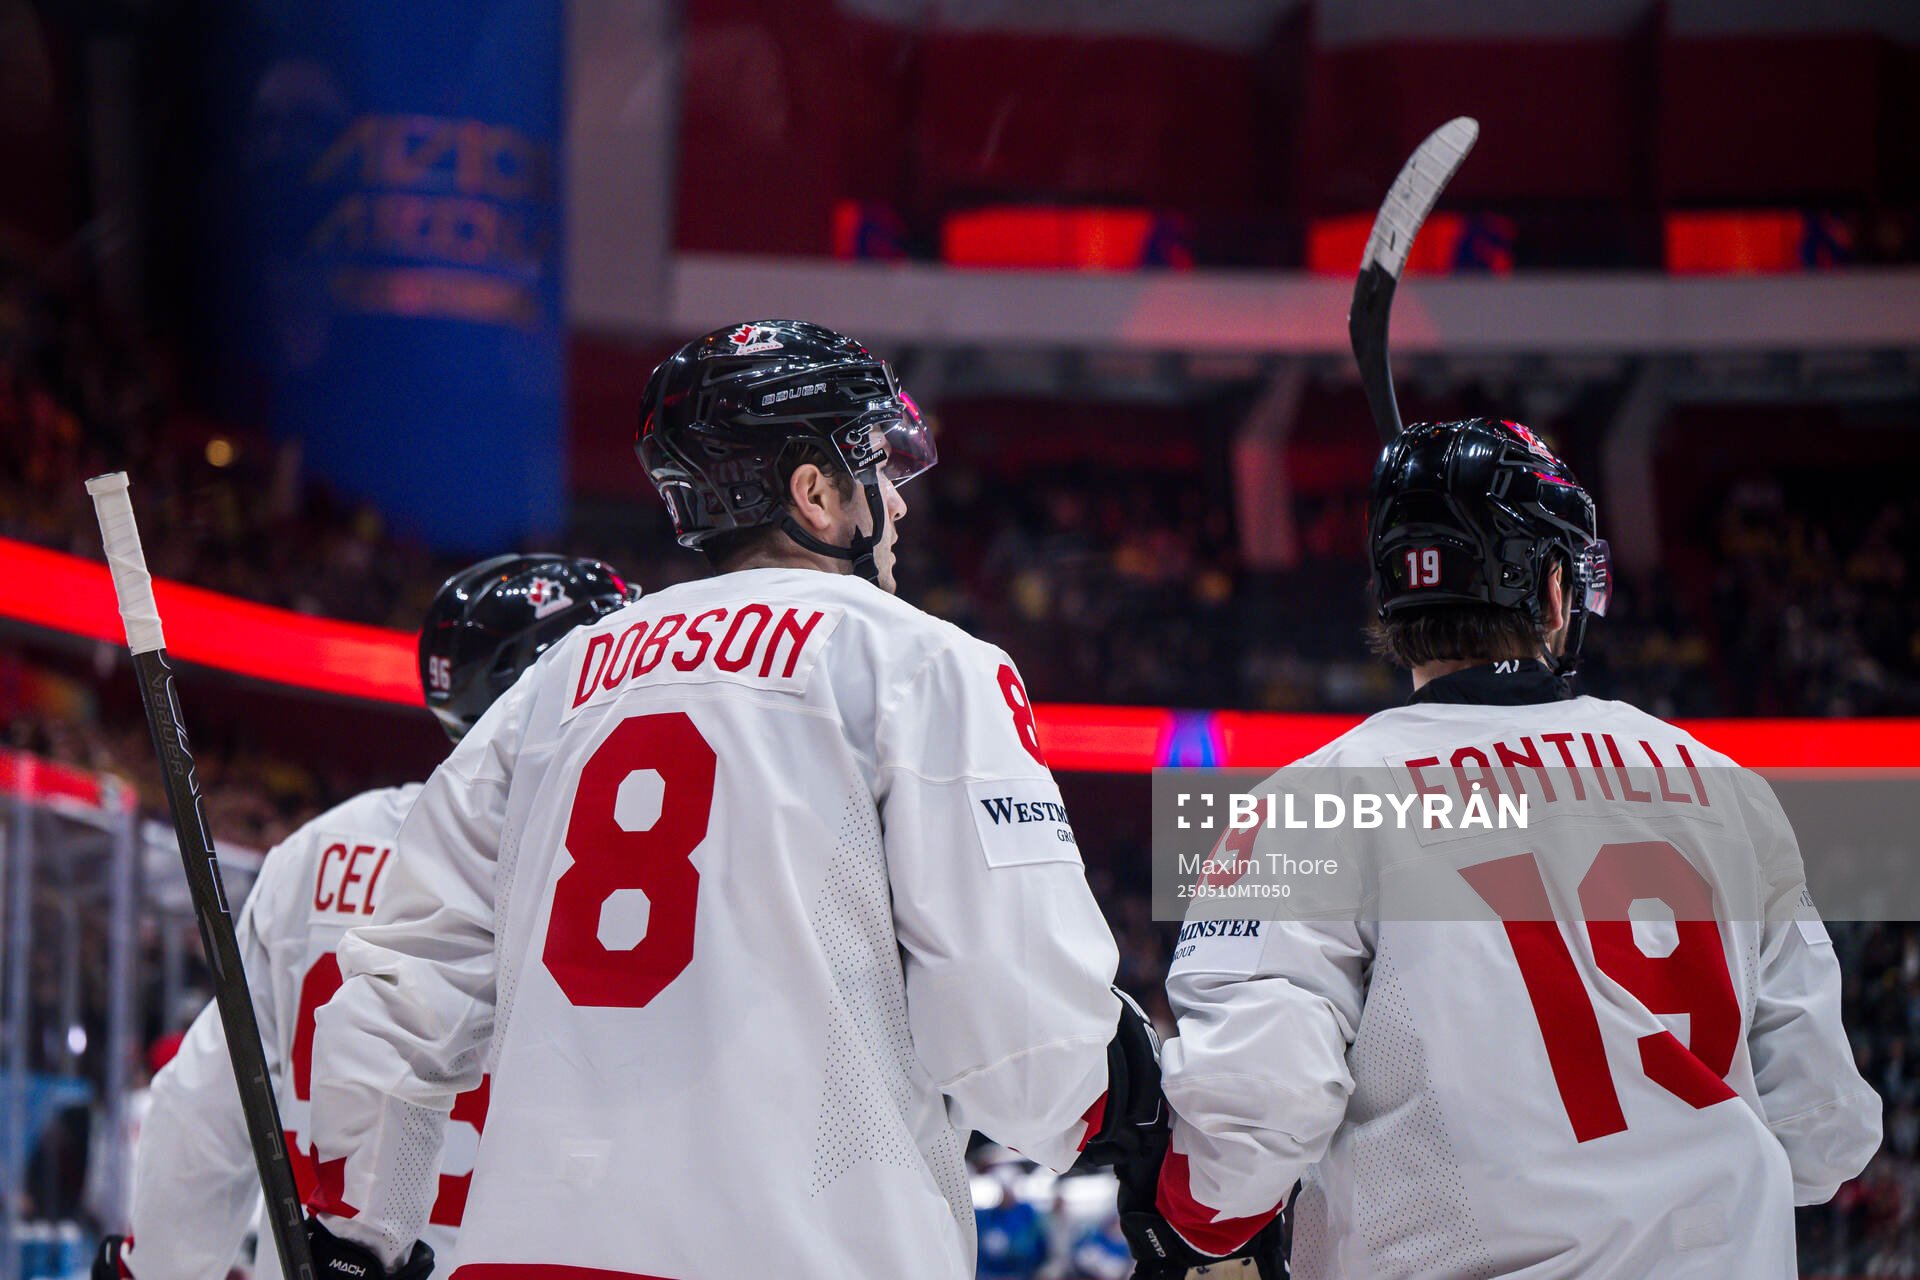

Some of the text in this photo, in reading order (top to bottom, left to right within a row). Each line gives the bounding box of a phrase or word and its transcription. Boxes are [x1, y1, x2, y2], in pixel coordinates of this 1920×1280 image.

[1405, 547, 1442, 589] 19
[429, 655, 451, 690] 96
[572, 603, 824, 709] DOBSON
[997, 663, 1048, 768] 8
[1405, 732, 1711, 830] FANTILLI
[541, 712, 717, 1008] 8
[1458, 841, 1742, 1143] 19
[328, 1257, 367, 1277] MACH
